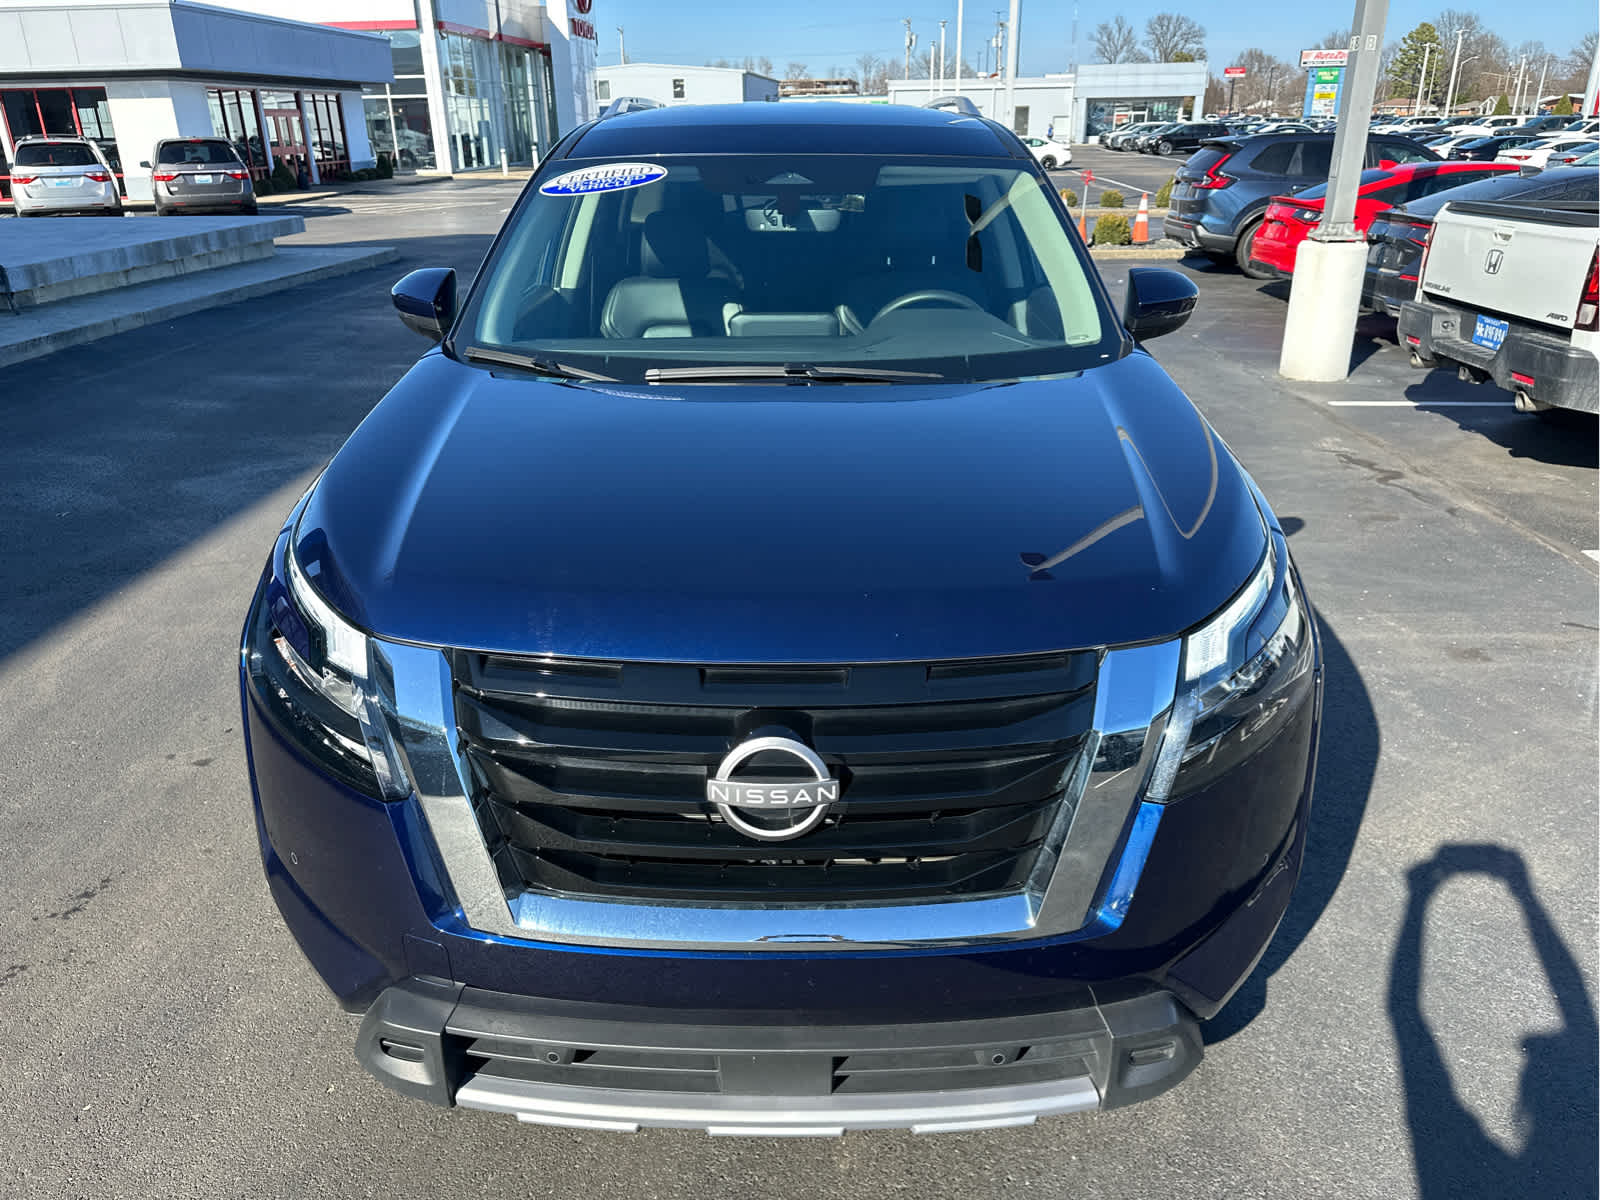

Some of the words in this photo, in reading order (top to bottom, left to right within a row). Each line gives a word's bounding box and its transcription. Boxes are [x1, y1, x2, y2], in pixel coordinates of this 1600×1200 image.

[557, 166, 653, 185] CERTIFIED
[569, 180, 632, 192] VEHICLE
[711, 785, 837, 804] NISSAN
